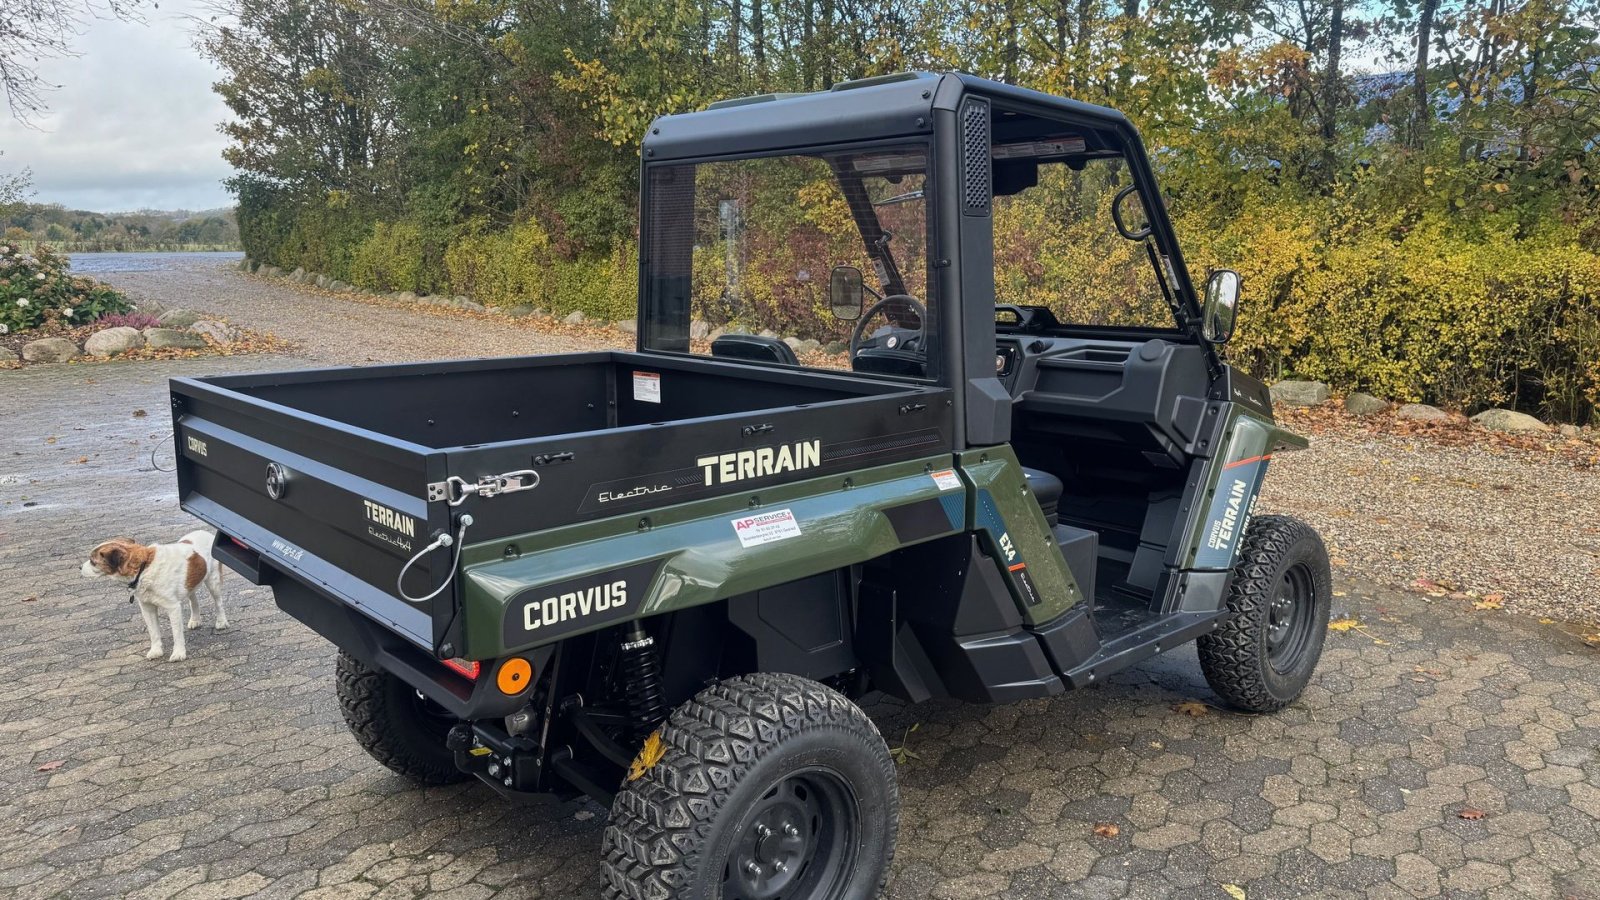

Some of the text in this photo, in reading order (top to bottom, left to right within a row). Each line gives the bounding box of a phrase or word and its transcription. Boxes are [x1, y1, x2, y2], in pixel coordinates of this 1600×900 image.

[187, 436, 207, 456] CORVUS
[698, 440, 820, 486] TERRAIN
[598, 485, 672, 502] Electric
[364, 500, 414, 537] TERRAIN
[1215, 479, 1246, 550] TERRAIN
[999, 532, 1016, 561] EX4
[1208, 519, 1221, 548] CORVUS
[524, 580, 627, 631] CORVUS
